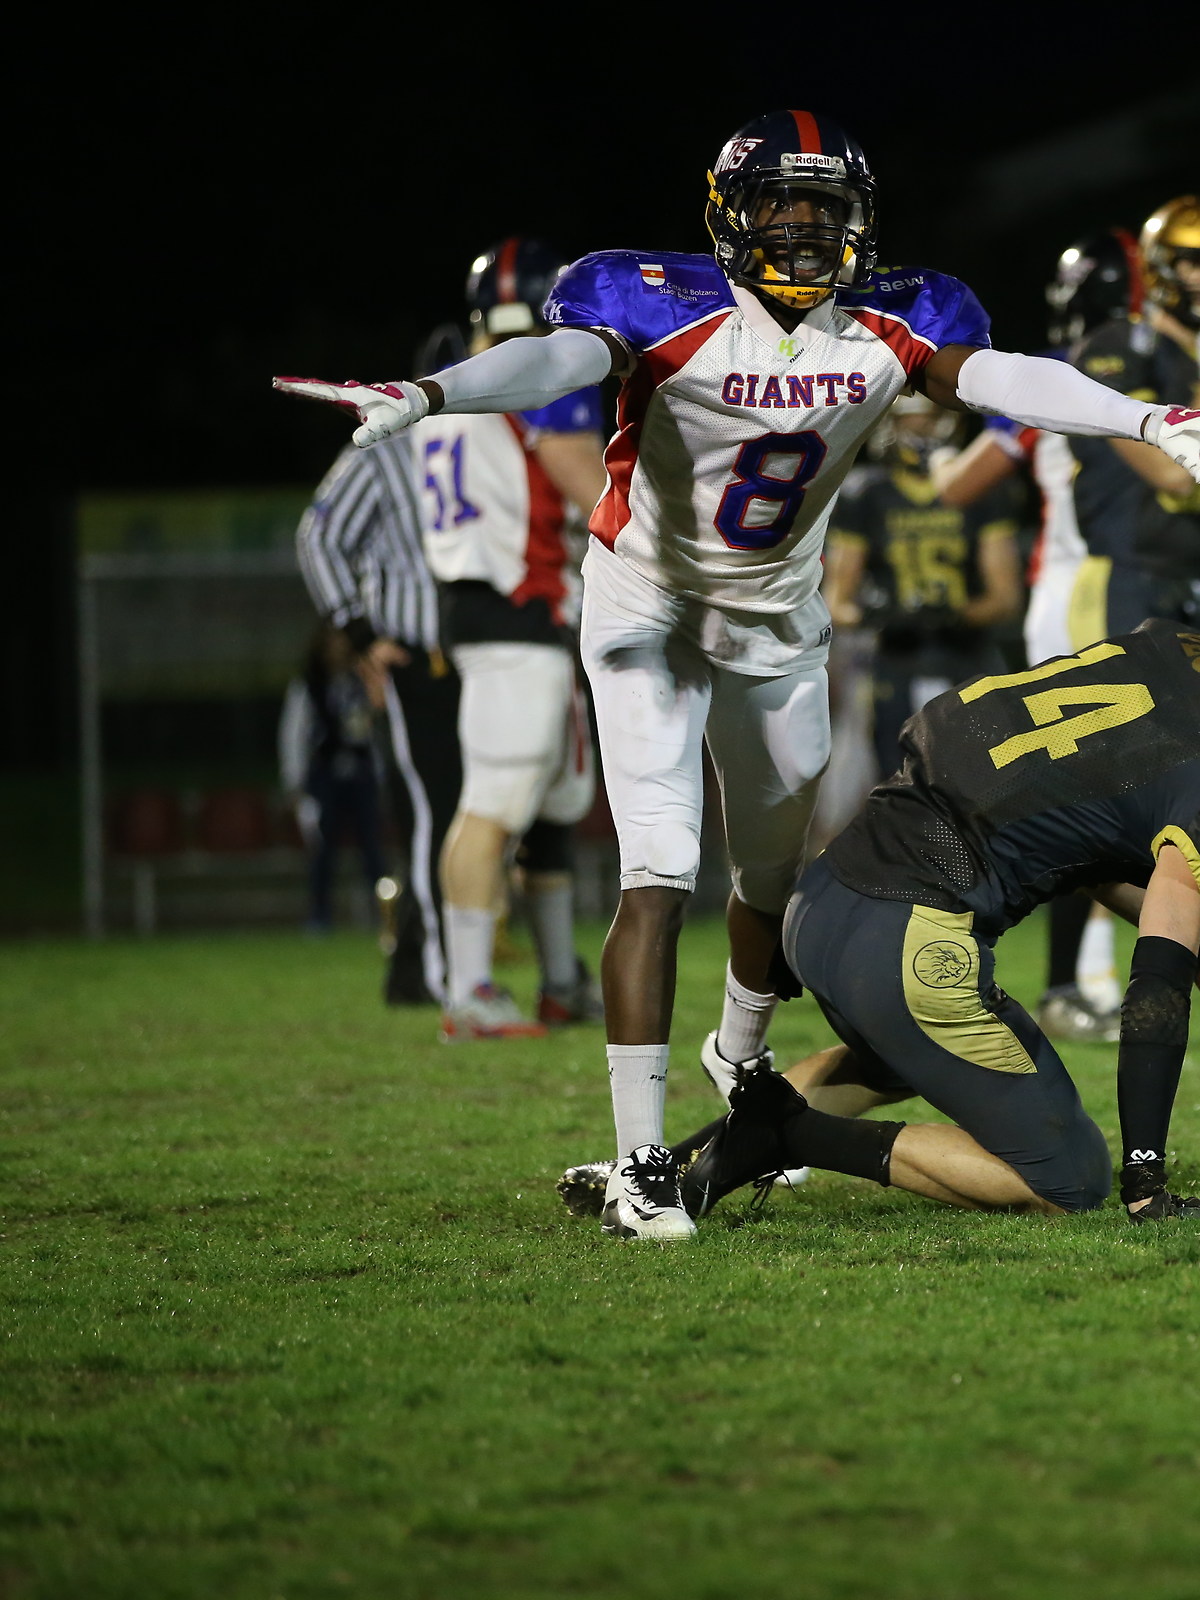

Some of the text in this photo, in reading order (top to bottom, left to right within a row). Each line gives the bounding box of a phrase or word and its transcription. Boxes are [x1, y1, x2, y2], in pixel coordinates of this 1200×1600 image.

[796, 155, 830, 167] Riddell
[689, 288, 719, 296] Bolzano
[879, 275, 925, 292] aew
[721, 371, 867, 409] GIANTS
[425, 432, 481, 532] 51
[713, 429, 829, 551] 8
[957, 641, 1157, 770] 14
